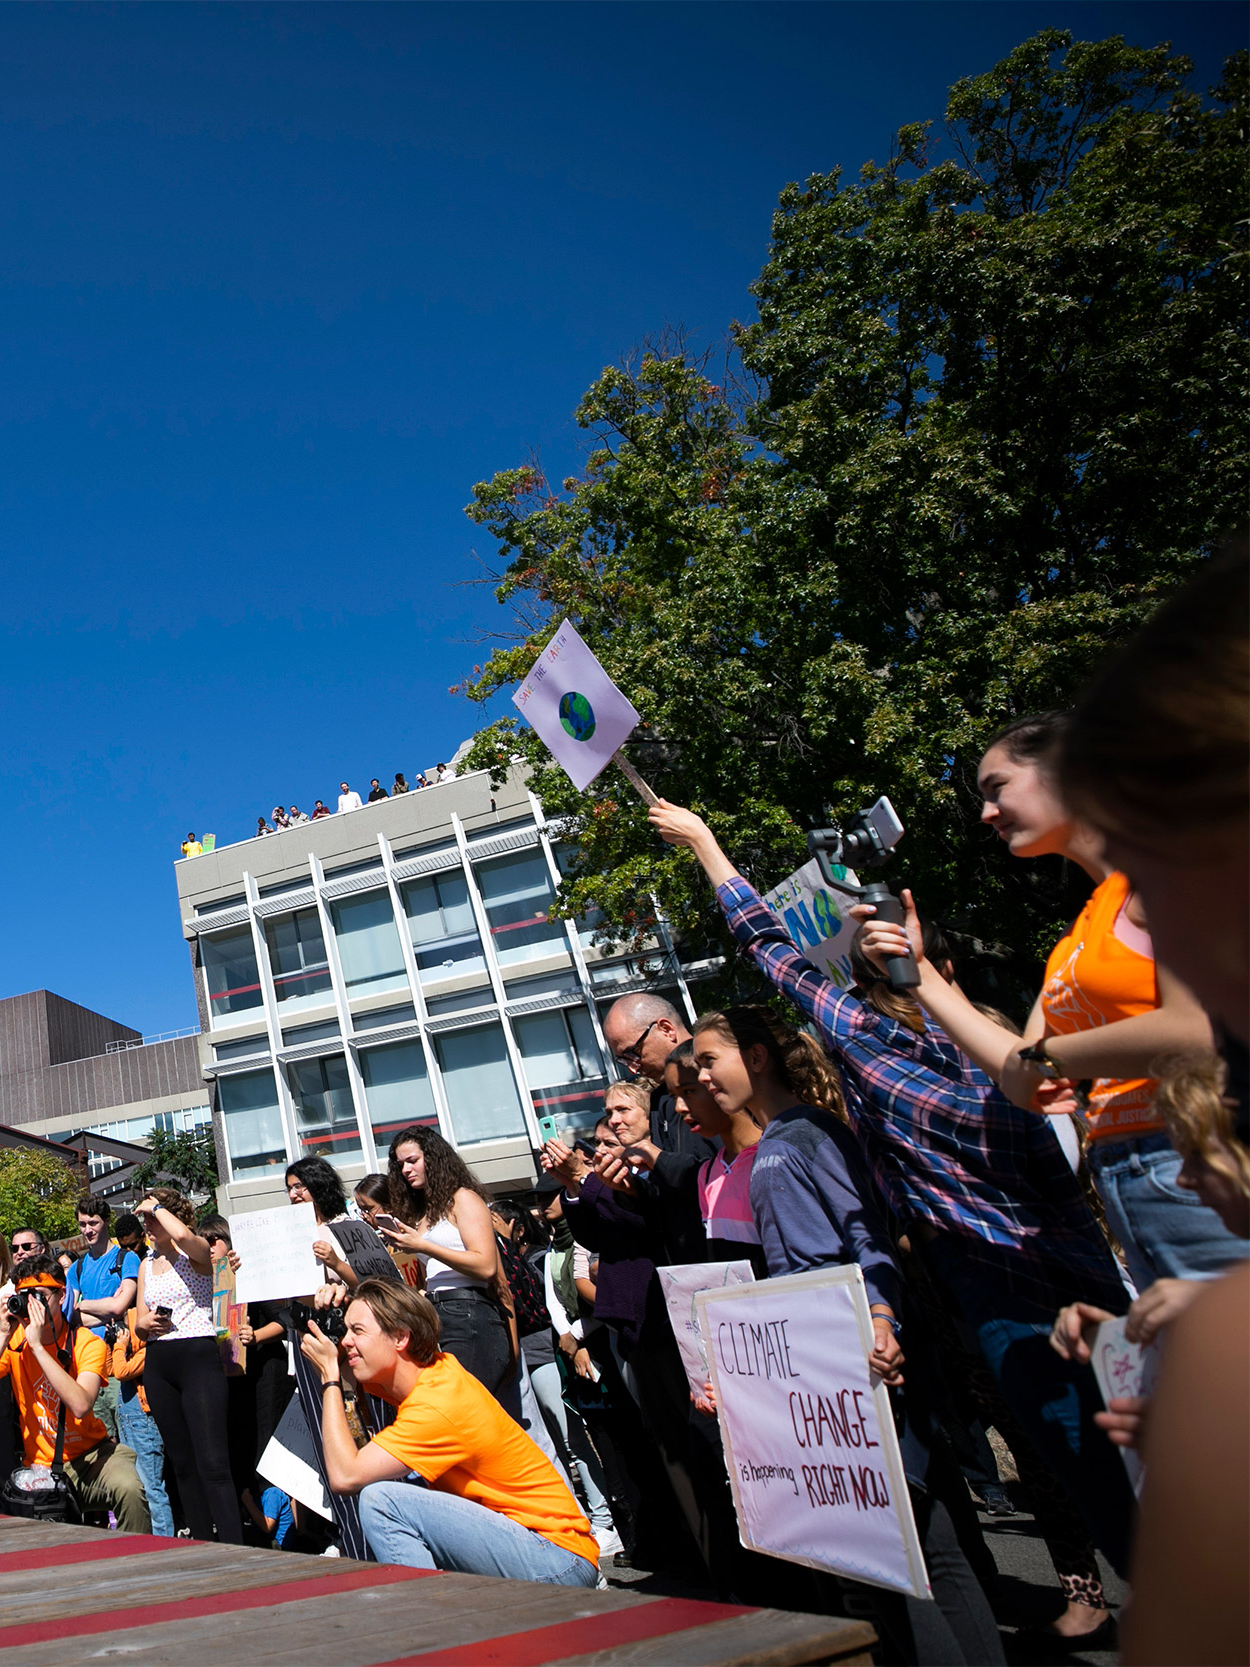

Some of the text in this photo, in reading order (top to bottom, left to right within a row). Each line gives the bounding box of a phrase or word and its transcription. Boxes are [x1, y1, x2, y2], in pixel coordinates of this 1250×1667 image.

[518, 634, 567, 705] SAVE THE EARTH
[790, 879, 802, 897] is
[718, 1319, 800, 1380] CLIMATE
[789, 1388, 879, 1450] CHANGE
[739, 1459, 890, 1512] is happening RIGHT NOW
